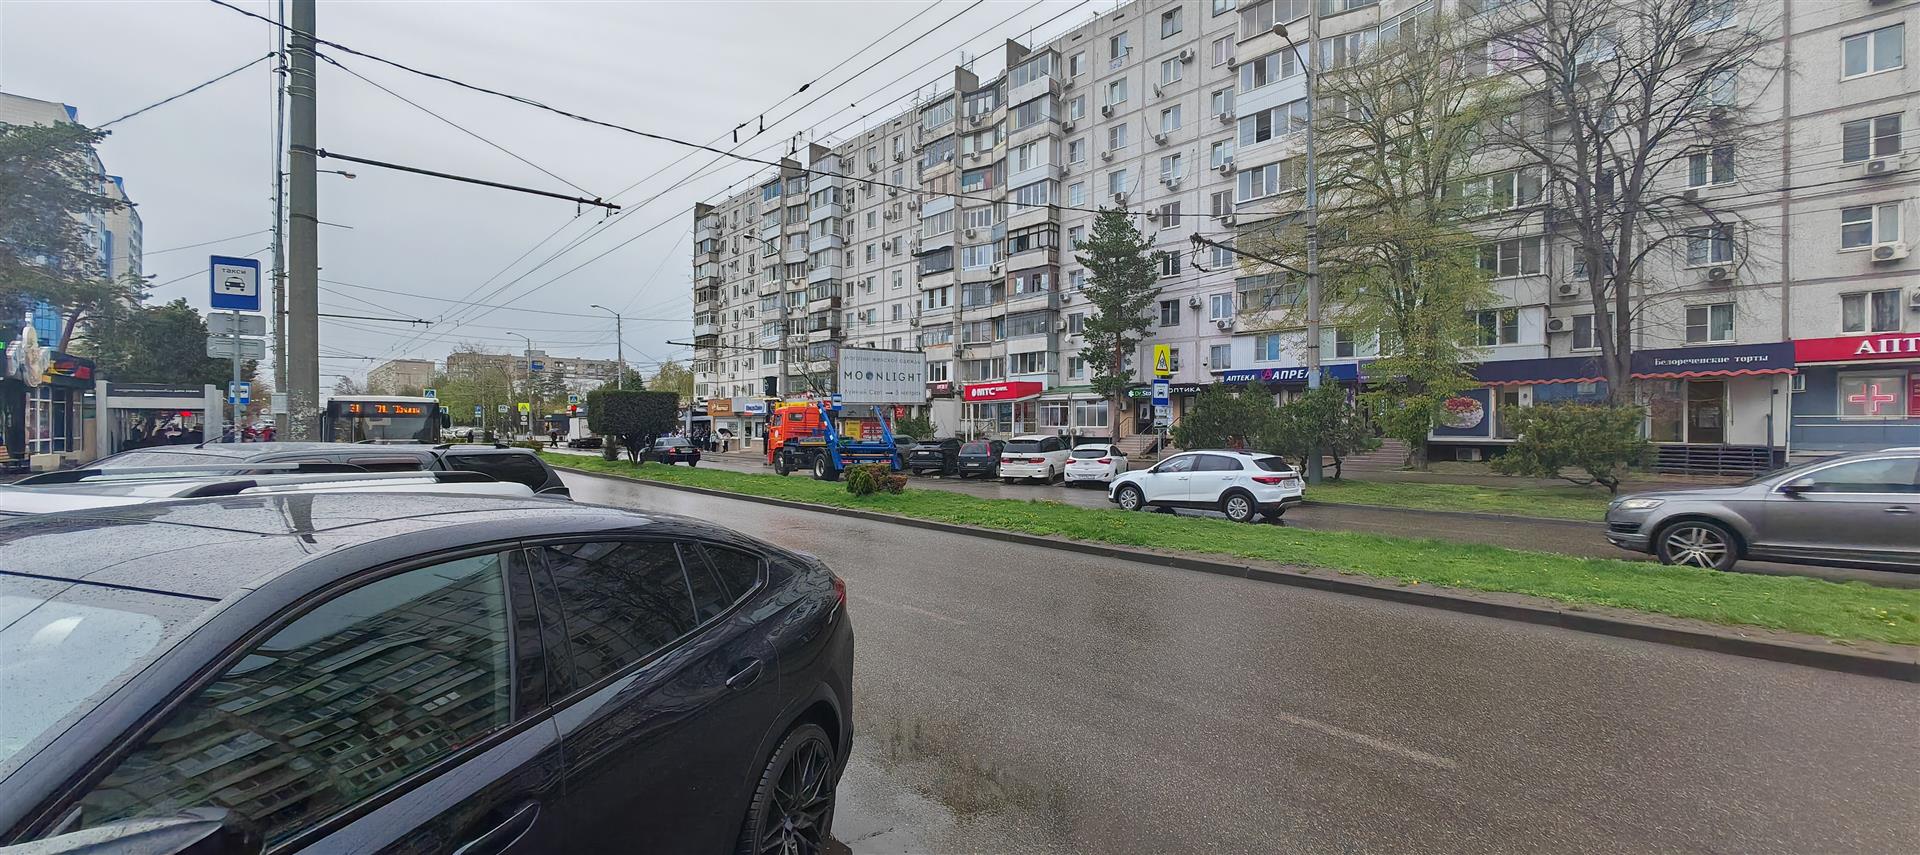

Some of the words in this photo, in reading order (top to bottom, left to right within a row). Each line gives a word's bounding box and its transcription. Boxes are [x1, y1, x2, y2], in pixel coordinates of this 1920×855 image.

[1853, 337, 1920, 355] АПТ
[1654, 357, 1730, 366] Белореченские
[1734, 355, 1768, 363] торты
[843, 370, 922, 382] MOONLIGHT
[1226, 374, 1255, 382] АПТЕКА
[977, 386, 996, 397] МТС
